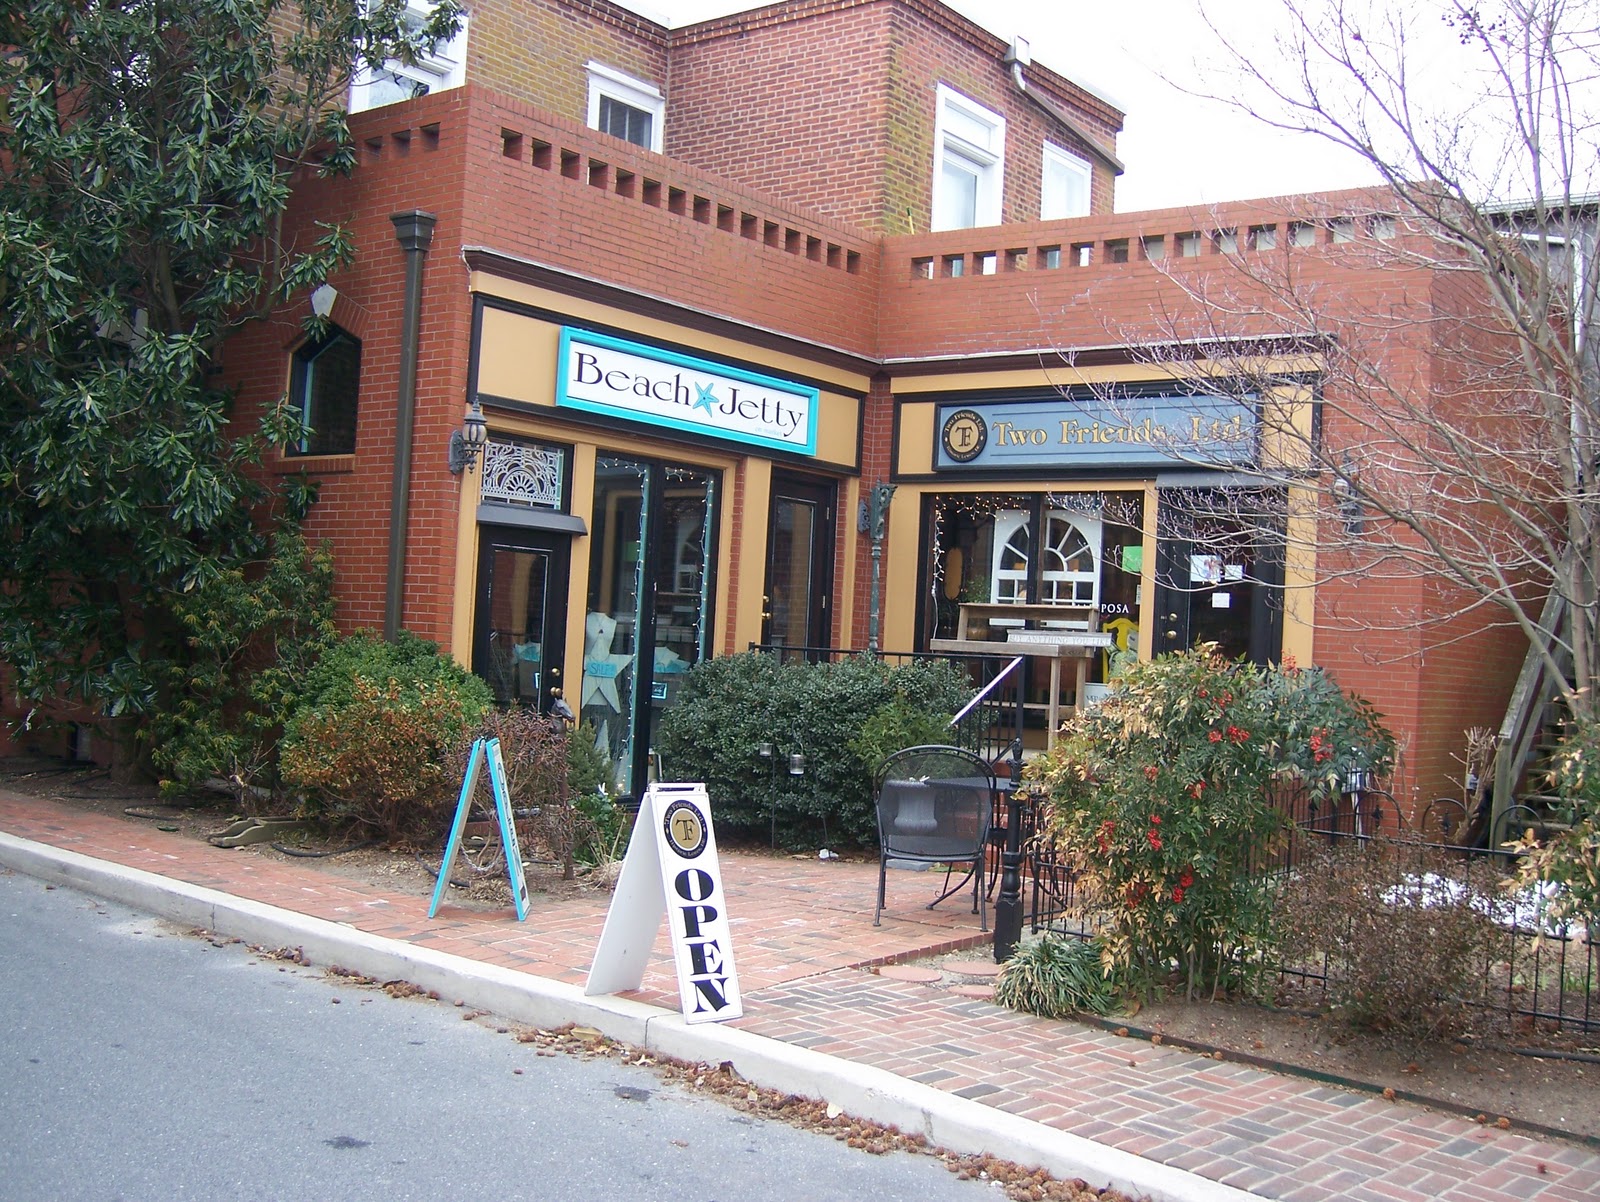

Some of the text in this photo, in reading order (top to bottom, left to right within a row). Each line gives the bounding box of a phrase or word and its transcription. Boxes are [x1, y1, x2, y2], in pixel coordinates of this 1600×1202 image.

[573, 351, 805, 437] Beach Jetty
[992, 422, 1048, 446] Two
[674, 868, 730, 1014] OPEN
